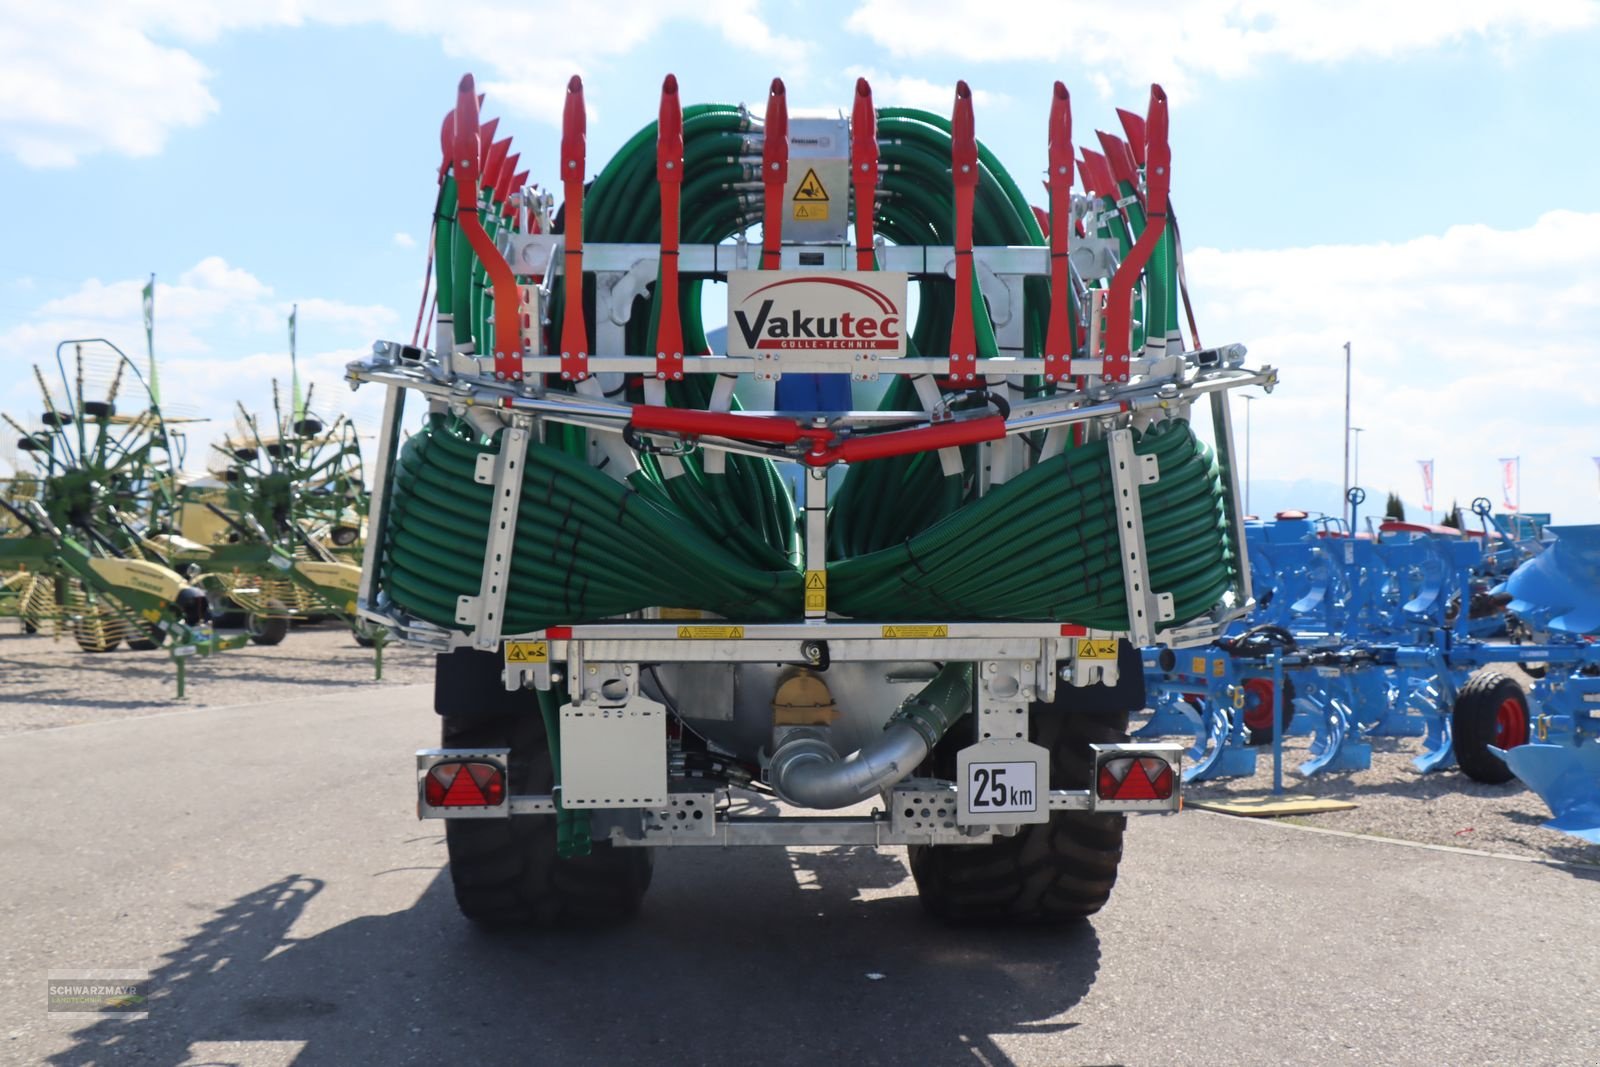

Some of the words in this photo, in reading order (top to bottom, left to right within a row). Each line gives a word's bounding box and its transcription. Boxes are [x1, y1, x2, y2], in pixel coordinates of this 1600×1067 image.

[734, 299, 900, 350] Vakutec
[973, 768, 1007, 807] 25
[1010, 786, 1032, 806] km
